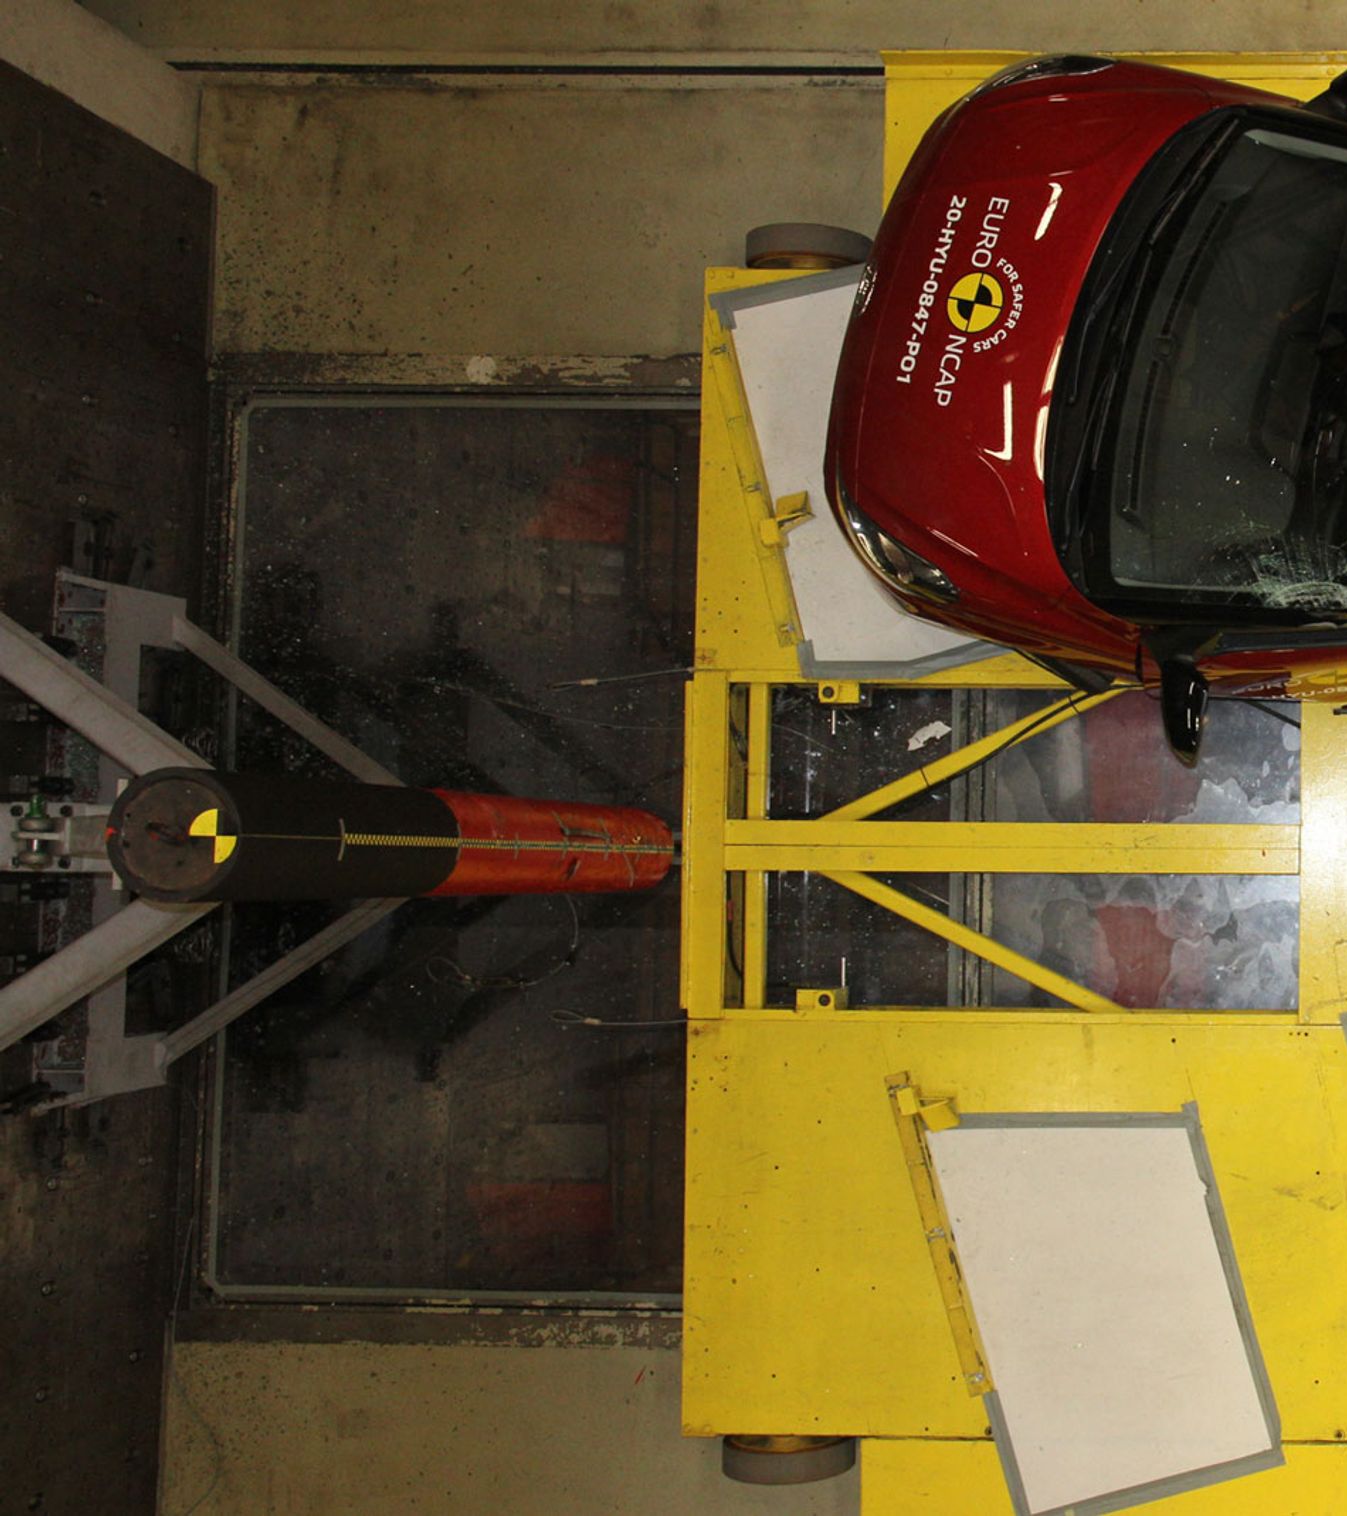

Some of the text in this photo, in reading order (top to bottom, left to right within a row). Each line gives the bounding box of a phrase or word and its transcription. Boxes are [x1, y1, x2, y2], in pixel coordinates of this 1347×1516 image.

[933, 197, 1010, 407] EURO NCAP
[973, 258, 1024, 353] FOR SAFER CARS
